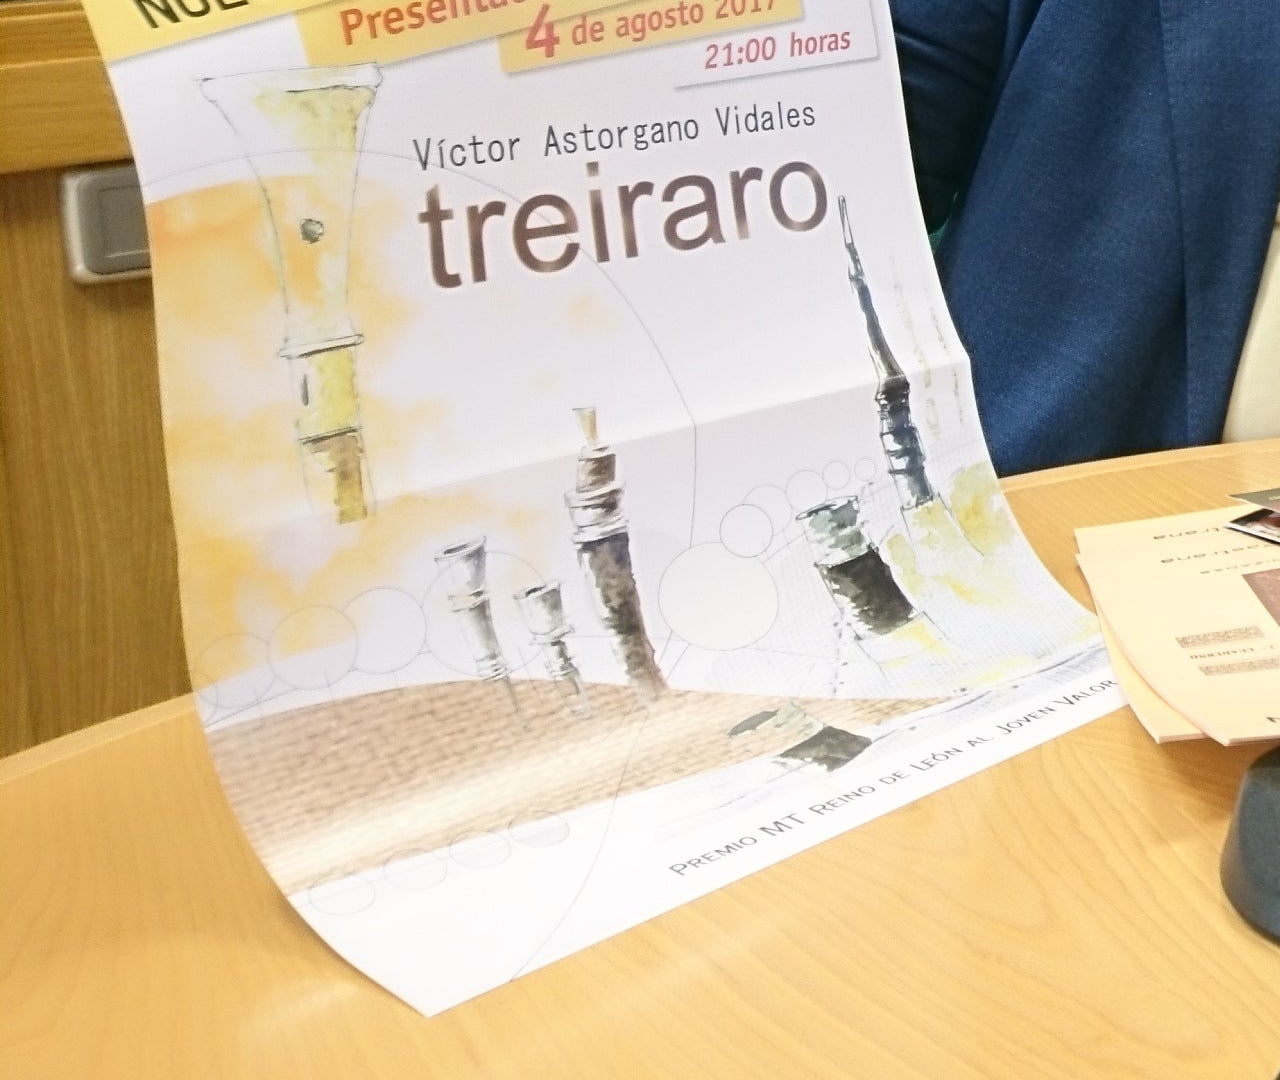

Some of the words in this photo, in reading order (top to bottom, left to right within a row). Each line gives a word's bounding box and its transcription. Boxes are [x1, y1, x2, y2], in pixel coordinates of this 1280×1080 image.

[525, 5, 561, 58] 4
[571, 14, 606, 47] de
[704, 34, 776, 70] 21:00
[789, 26, 852, 57] horas
[412, 132, 521, 171] Víctor
[543, 111, 701, 156] Astorgano
[714, 101, 817, 137] Vidales
[418, 160, 829, 290] treiraro
[668, 835, 758, 877] PREMIO
[759, 812, 809, 837] MT
[809, 784, 877, 818] REINO
[879, 769, 909, 787] DE
[910, 746, 965, 773] LEÓN
[967, 734, 996, 748] AL
[1000, 705, 1057, 737] JOVEN
[1052, 678, 1120, 709] VALOR
